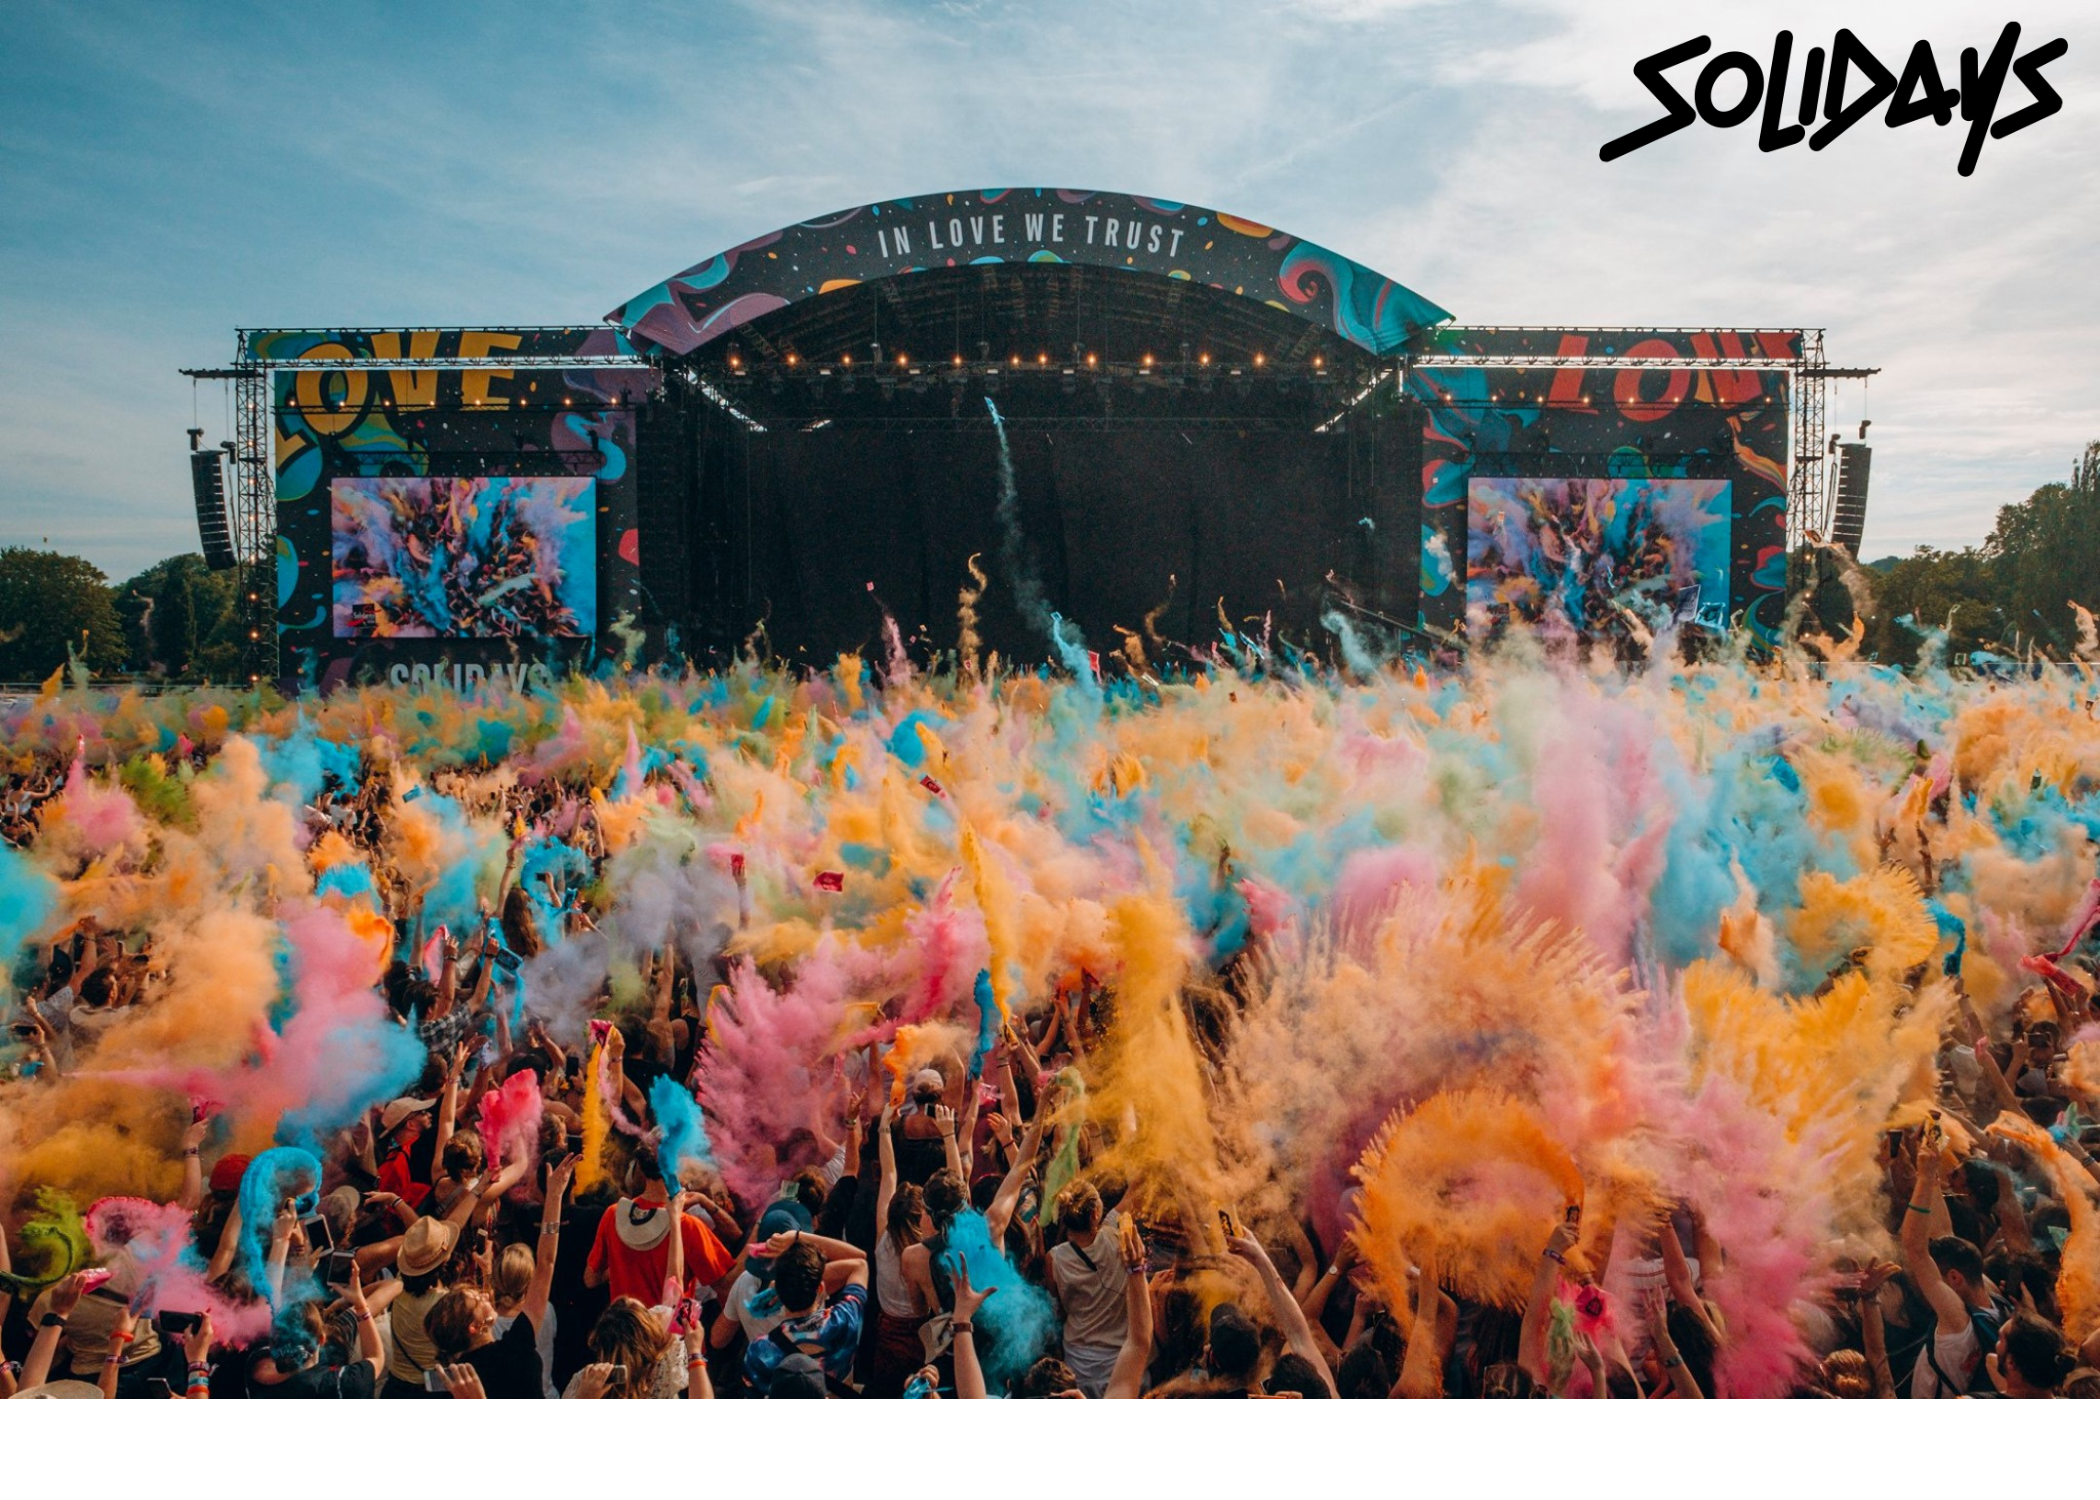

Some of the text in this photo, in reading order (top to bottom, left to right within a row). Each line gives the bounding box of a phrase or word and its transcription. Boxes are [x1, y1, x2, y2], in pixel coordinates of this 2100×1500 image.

[878, 213, 1184, 258] IN LOVE WE TRUST
[275, 331, 523, 462] OVE
